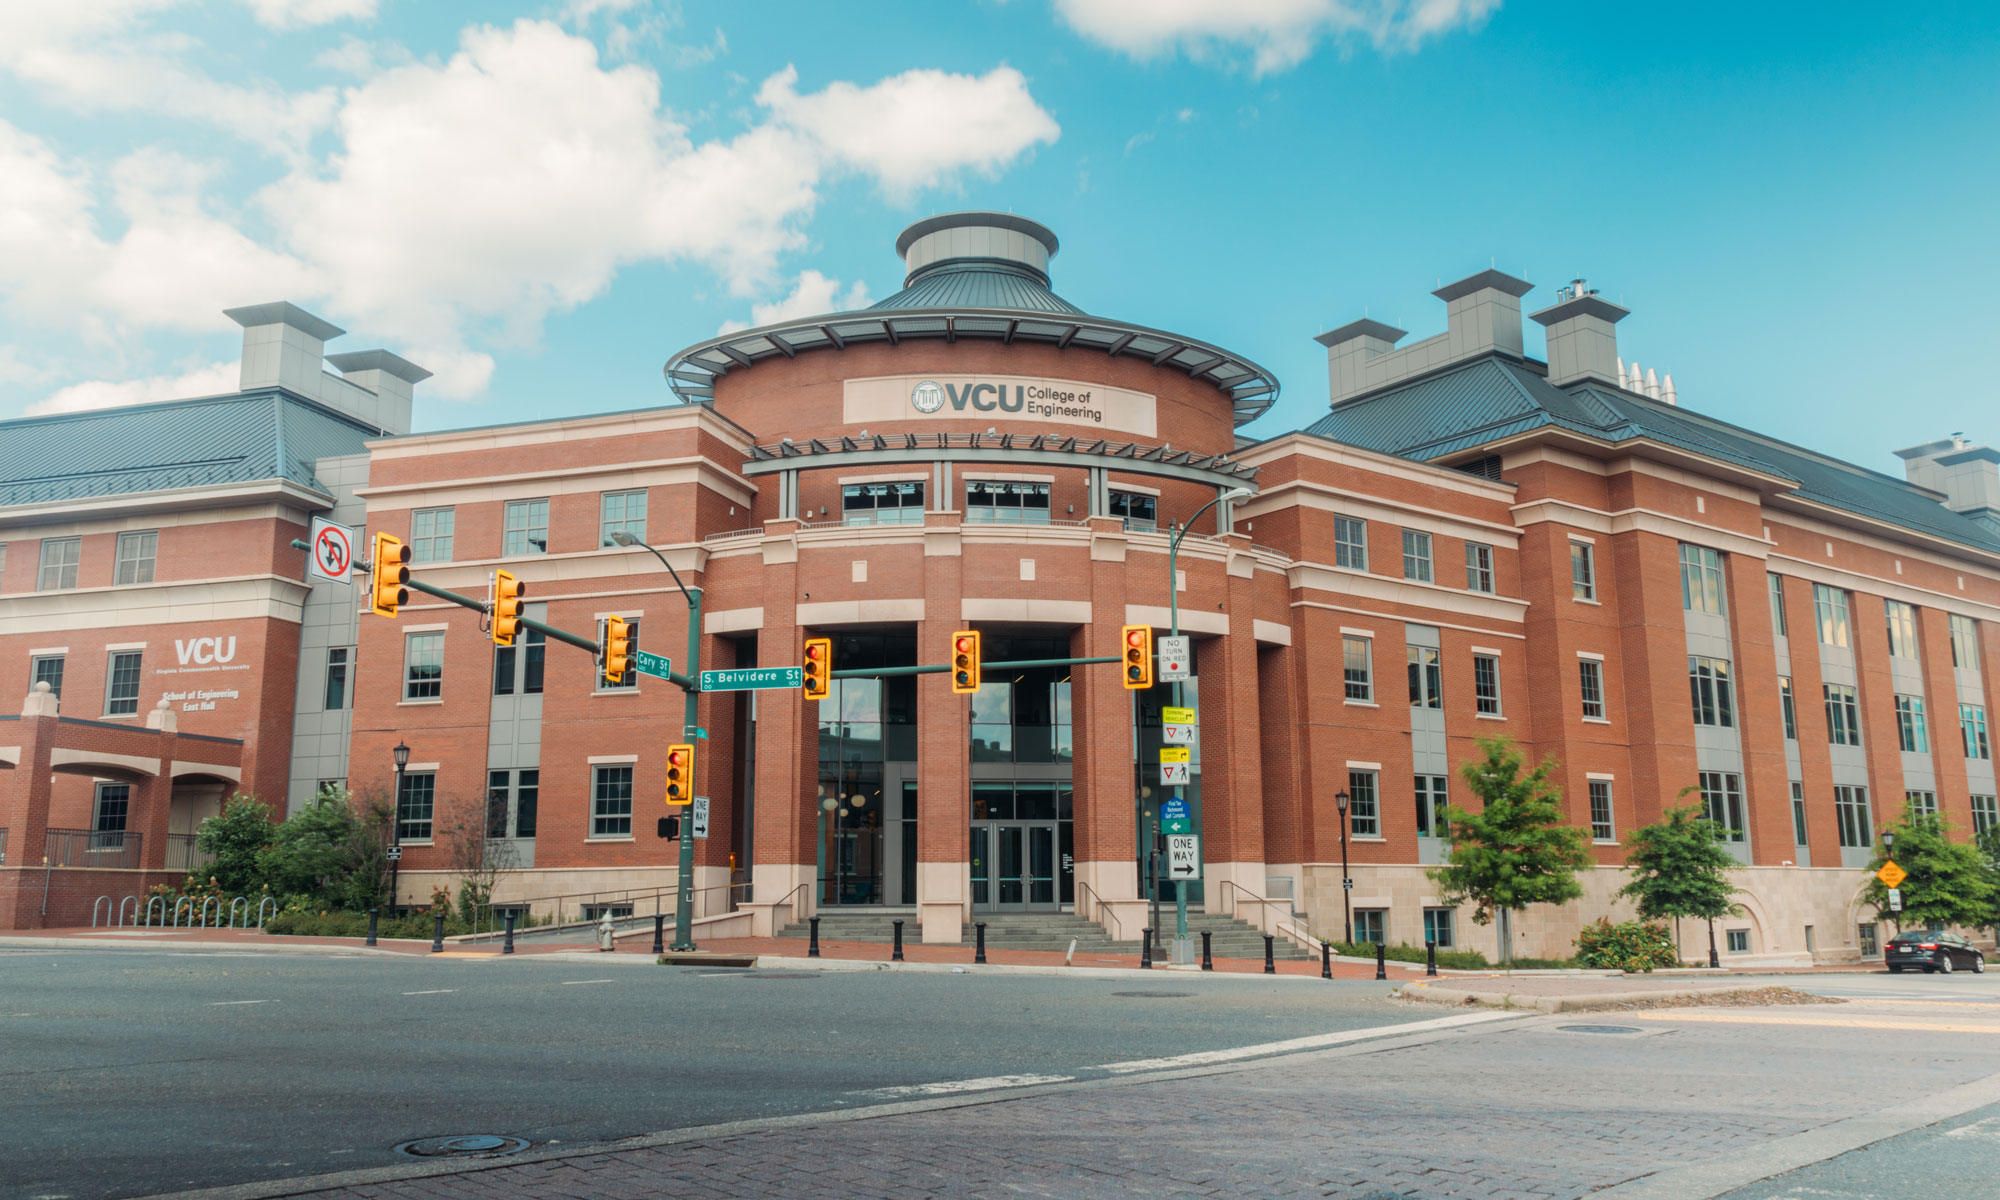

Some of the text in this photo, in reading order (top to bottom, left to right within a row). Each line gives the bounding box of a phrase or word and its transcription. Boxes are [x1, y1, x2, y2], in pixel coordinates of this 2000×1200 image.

[945, 383, 1024, 413] VCU
[1027, 386, 1091, 404] College of
[1027, 401, 1102, 422] Engineering
[175, 636, 237, 665] VCU
[639, 653, 668, 671] Cary St
[704, 669, 799, 684] S. Belvidere St
[162, 689, 239, 701] School of Engineering
[183, 701, 216, 712] East Hall
[695, 800, 707, 810] ONE
[695, 812, 707, 821] WAY
[1173, 838, 1193, 849] ONE
[1173, 851, 1194, 861] WAY
